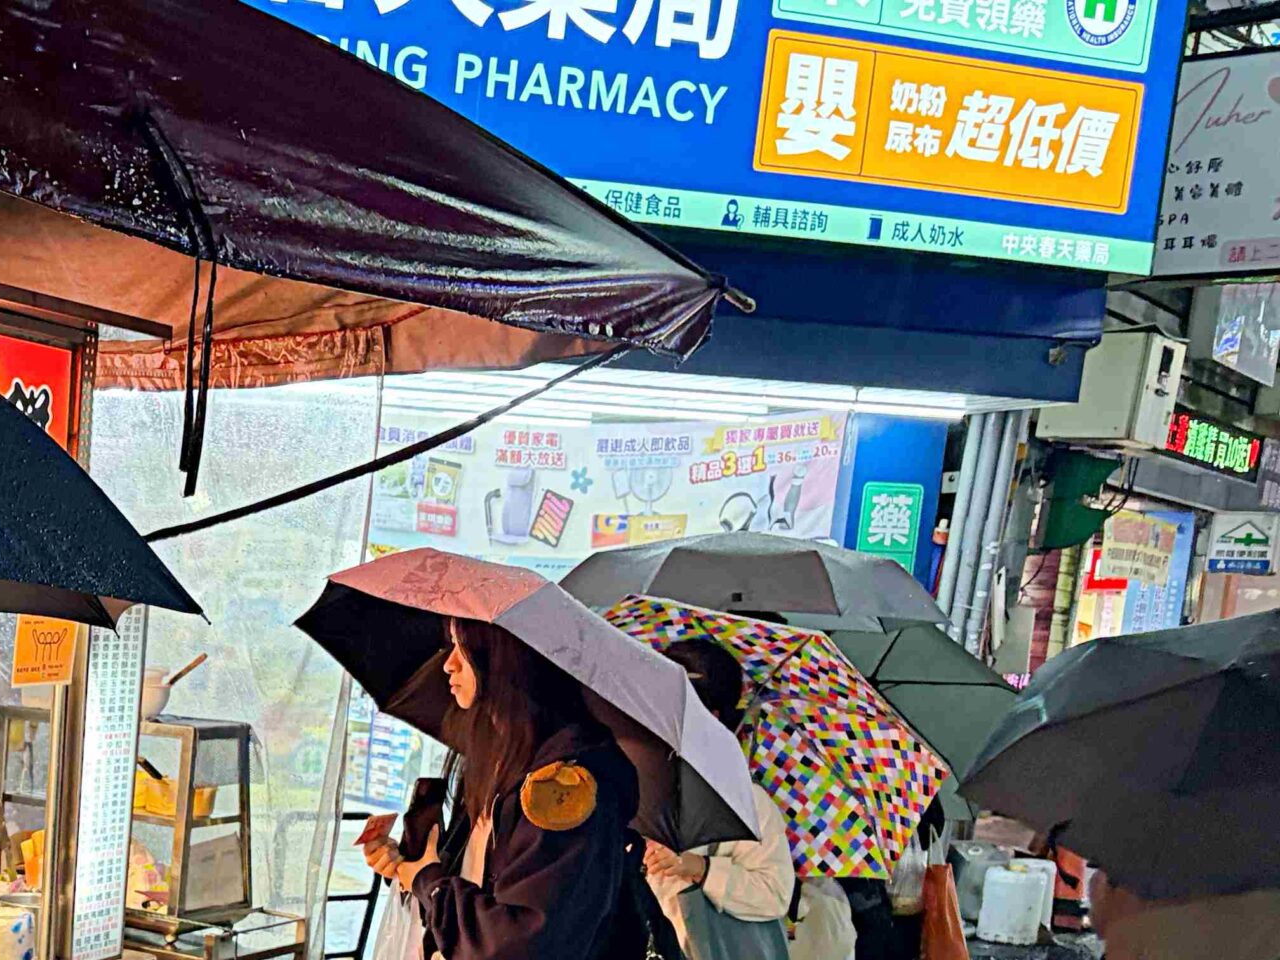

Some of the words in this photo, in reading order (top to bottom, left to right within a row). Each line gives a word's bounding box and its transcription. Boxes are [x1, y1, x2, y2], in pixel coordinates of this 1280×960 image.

[454, 53, 729, 125] PHARMACY
[890, 79, 948, 119] 奶粉
[775, 52, 859, 162] 嬰
[884, 121, 941, 158] 尿布
[946, 90, 1120, 177] 超低價
[604, 188, 682, 220] 保健食品
[752, 204, 828, 234] 輔具諮詢
[891, 221, 964, 247] 成人奶水
[1001, 232, 1110, 266] 中央春天藥局
[504, 430, 560, 447] 優質家電
[494, 448, 566, 467] 滿額大放送
[867, 493, 913, 546] 藥
